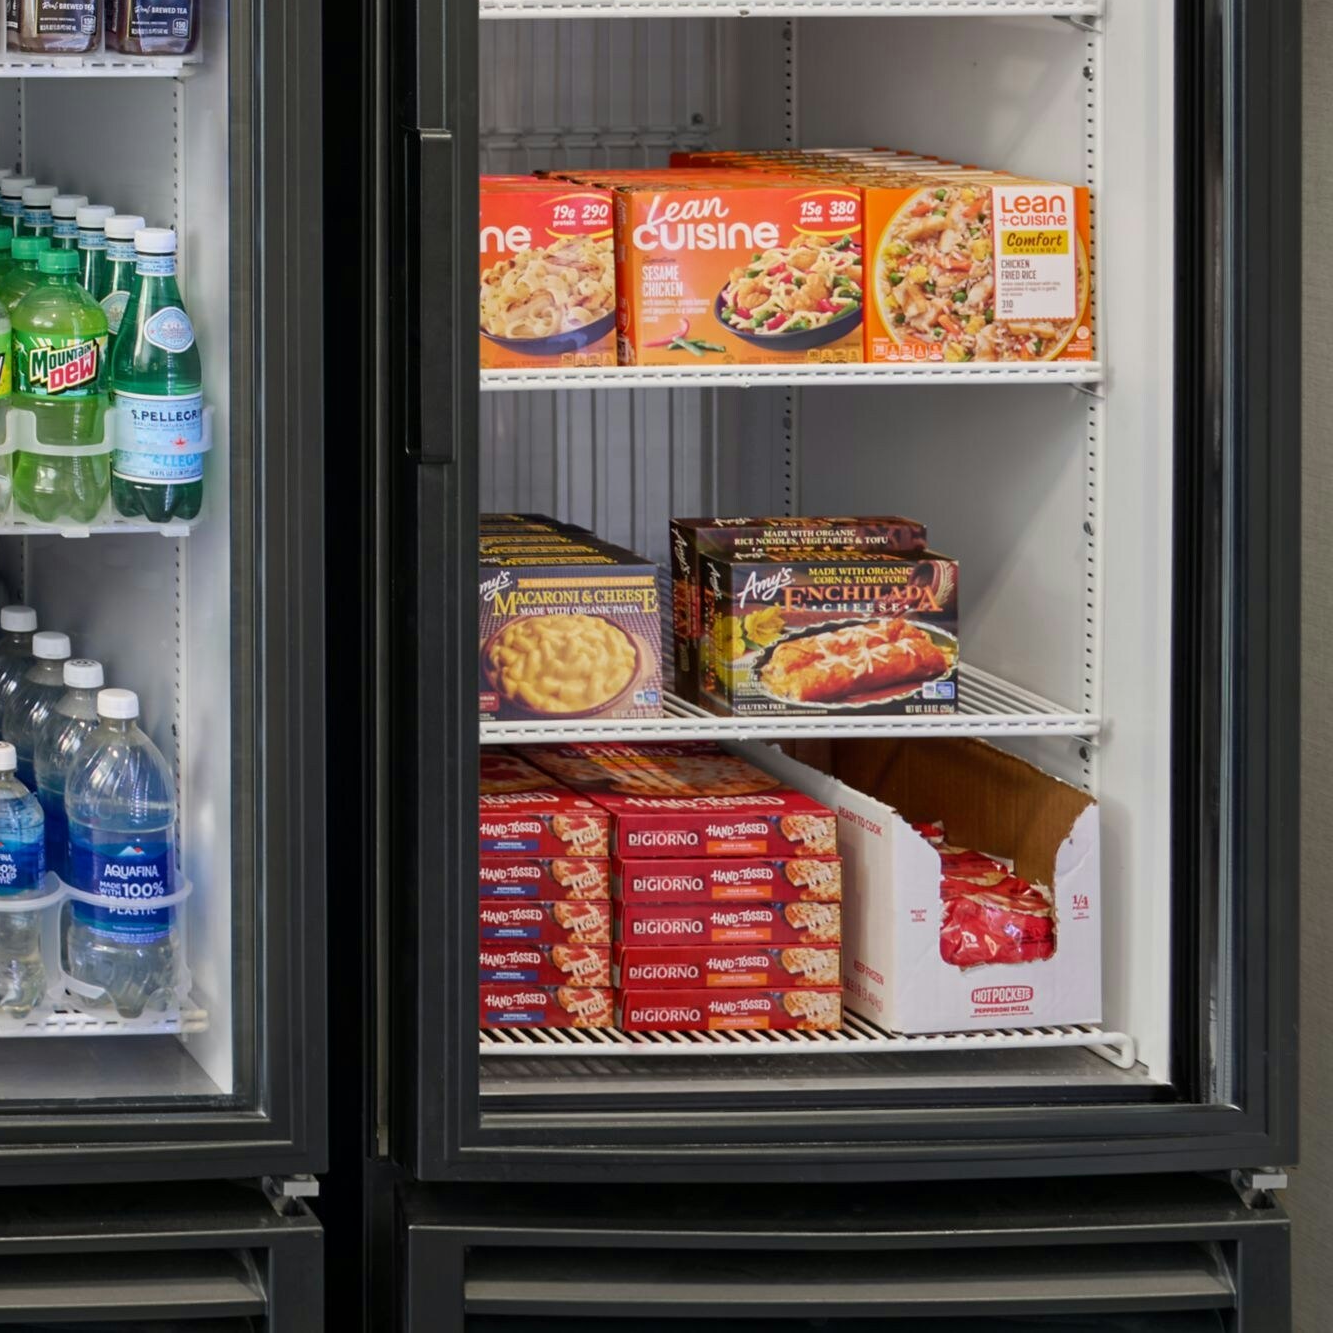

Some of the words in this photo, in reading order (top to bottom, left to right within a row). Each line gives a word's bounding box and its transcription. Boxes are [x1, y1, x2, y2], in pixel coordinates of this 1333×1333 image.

[648, 195, 729, 225] Lean
[1001, 195, 1065, 213] Lean
[1007, 233, 1062, 248] Comfort
[1001, 260, 1030, 269] CHICKEN
[1001, 270, 1020, 280] FRIED
[1022, 270, 1036, 280] RICE
[738, 567, 793, 608] Amy's
[494, 589, 580, 616] MACARONI
[782, 585, 942, 613] ENCHILADA
[519, 607, 538, 615] MADE
[540, 607, 558, 615] WITH
[560, 606, 605, 615] ORGANIC
[608, 605, 639, 614] PASTA
[628, 833, 699, 846] DIGIORNO
[104, 864, 158, 878] AQUAFINA
[122, 882, 164, 897] 100%
[974, 990, 993, 1002] HOT
[993, 987, 1031, 1002] POCKETS
[974, 1006, 1008, 1014] PEPPERONI
